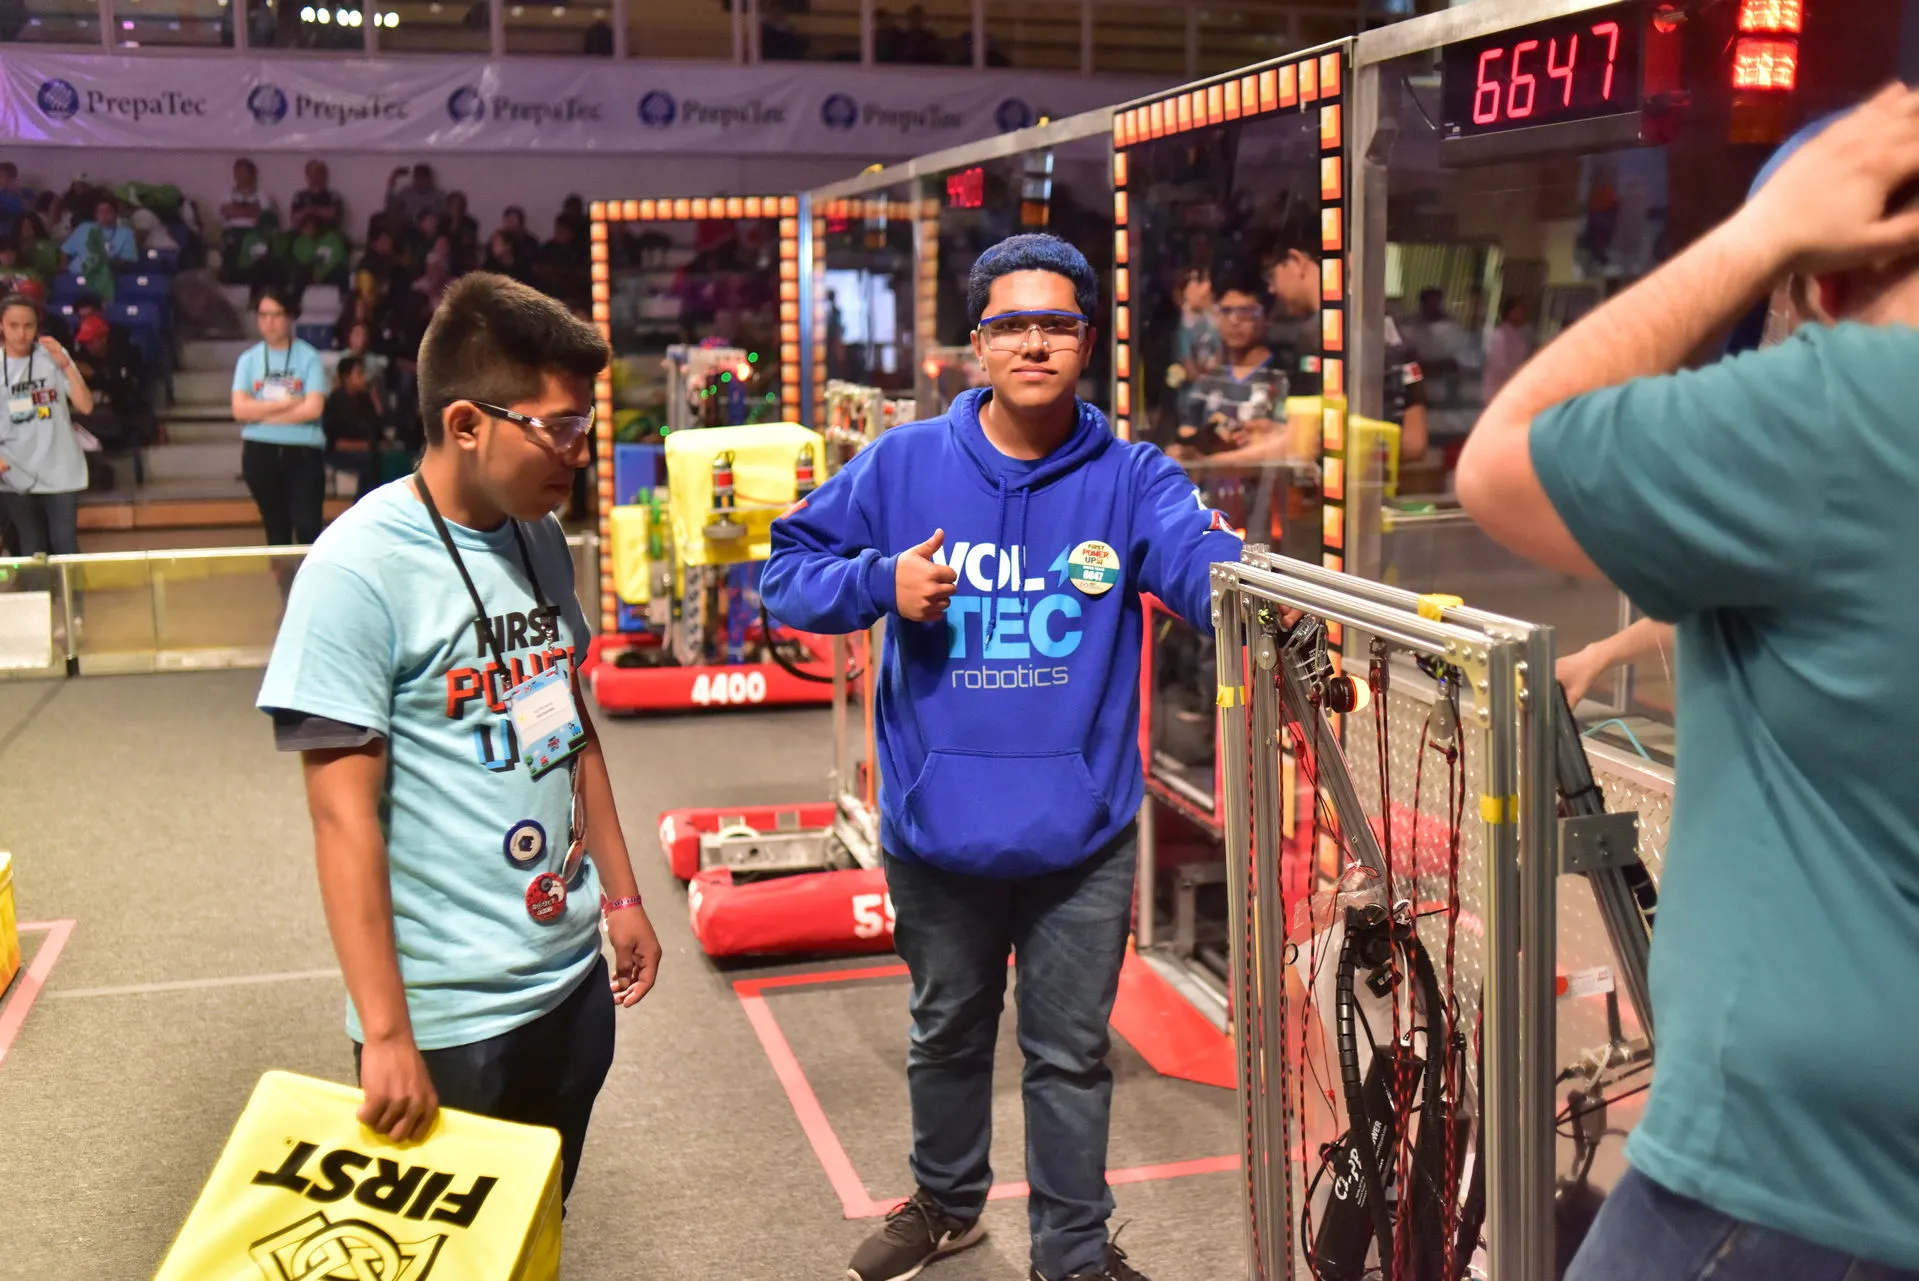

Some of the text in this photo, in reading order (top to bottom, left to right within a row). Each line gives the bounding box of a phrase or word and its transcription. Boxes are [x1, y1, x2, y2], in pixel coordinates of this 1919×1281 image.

[1473, 22, 1619, 125] 6647
[86, 90, 207, 121] PrepaTec
[296, 93, 409, 126] PrepaTec
[492, 96, 603, 125] PrepaTec
[932, 542, 1045, 592] VOL
[1082, 549, 1109, 558] POWER
[945, 594, 1083, 659] TEC
[691, 671, 767, 706] 4400
[952, 664, 1069, 688] robotics
[250, 1140, 500, 1230] FIRST
